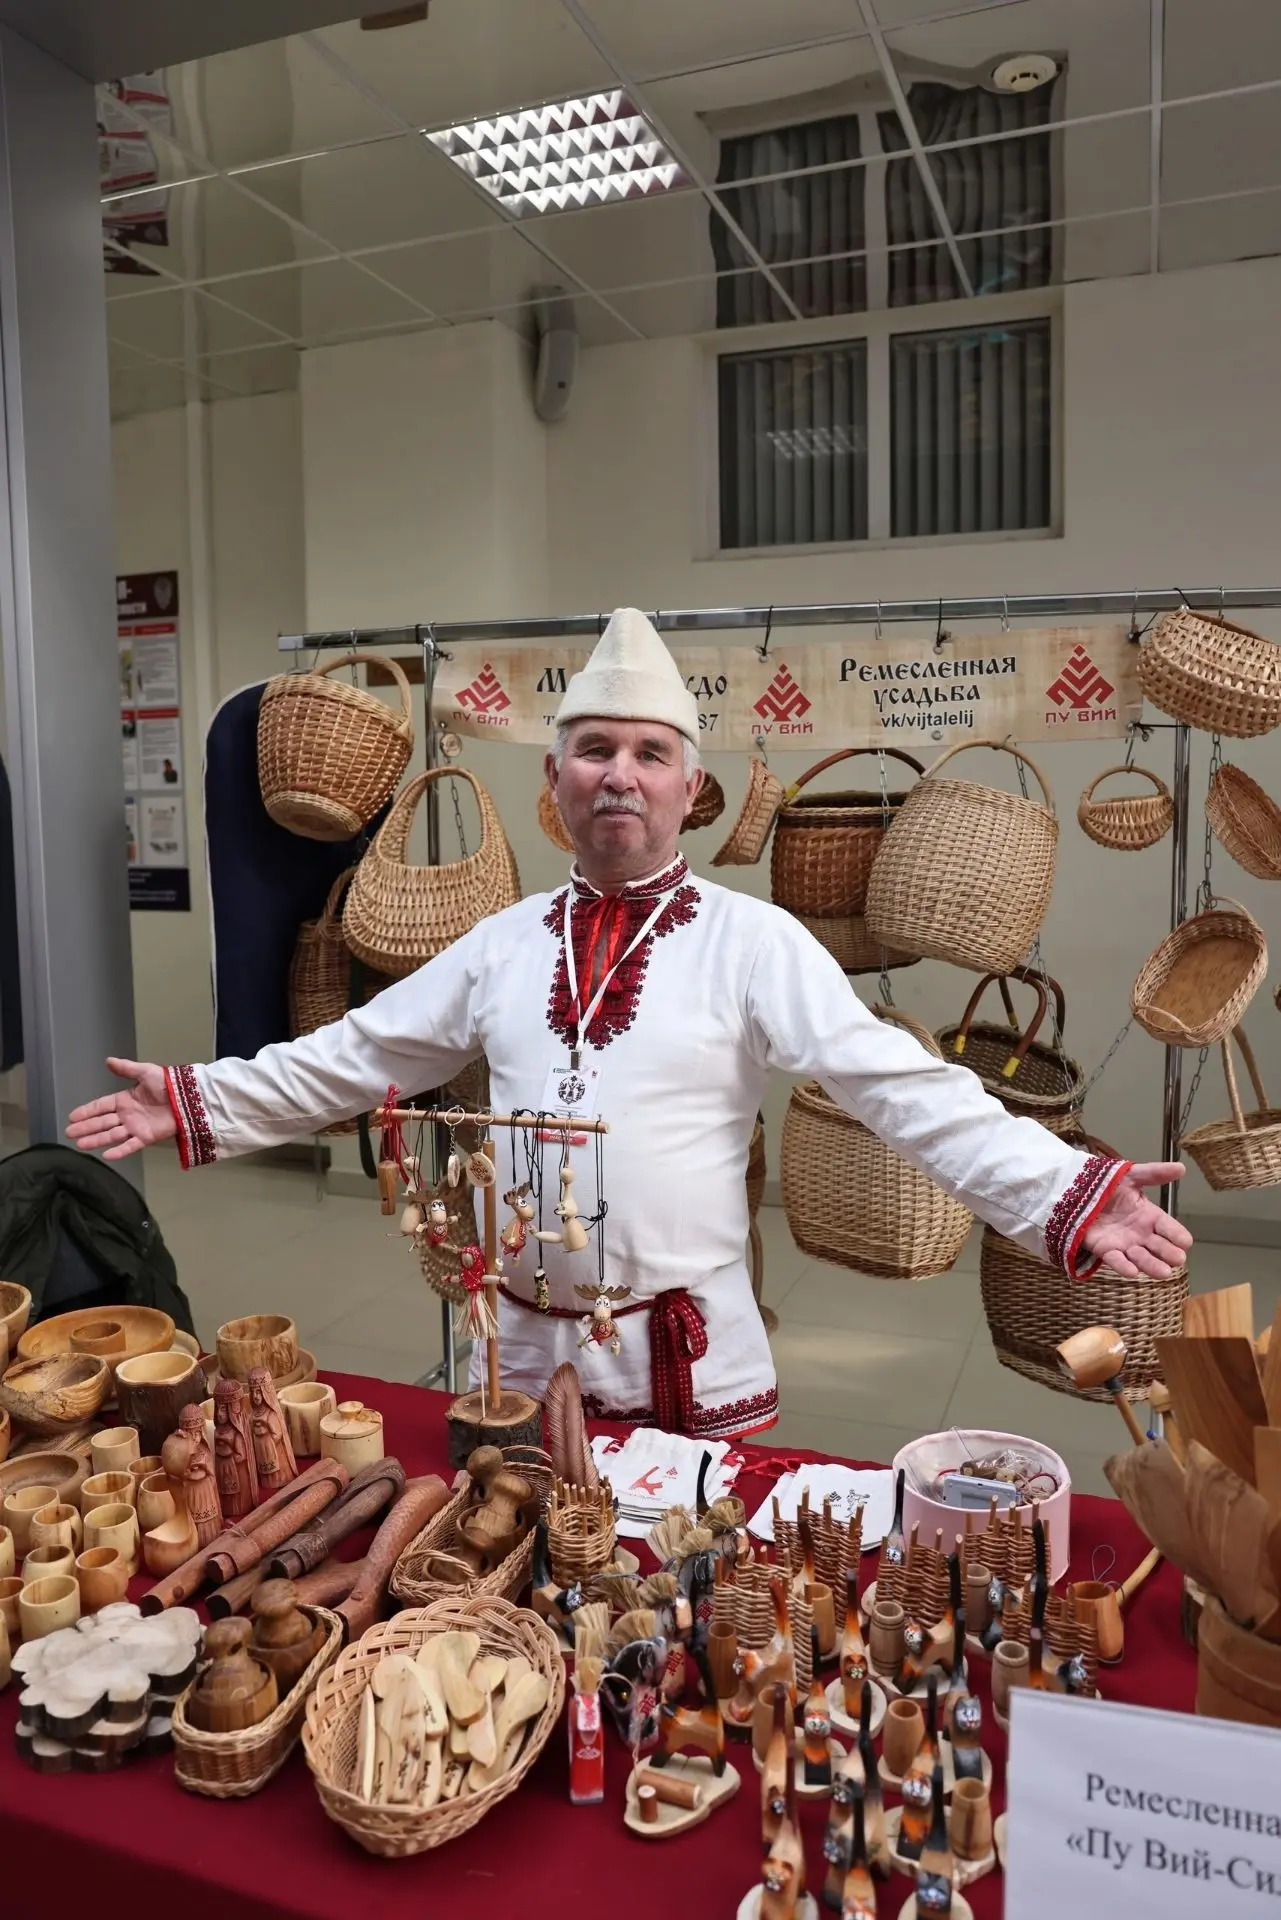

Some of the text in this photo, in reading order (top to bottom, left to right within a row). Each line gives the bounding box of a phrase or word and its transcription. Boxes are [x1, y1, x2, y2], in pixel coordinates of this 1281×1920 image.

[839, 656, 1016, 682] Ремесленная
[873, 684, 981, 713] усадьба
[453, 711, 472, 721] ПУ
[881, 709, 974, 731] vk/vijtalelij
[1045, 707, 1117, 723] ПУ ВИЙ
[751, 721, 813, 735] ПУ ВИЙ
[1066, 1826, 1281, 1897] «Пу Вий-Си
